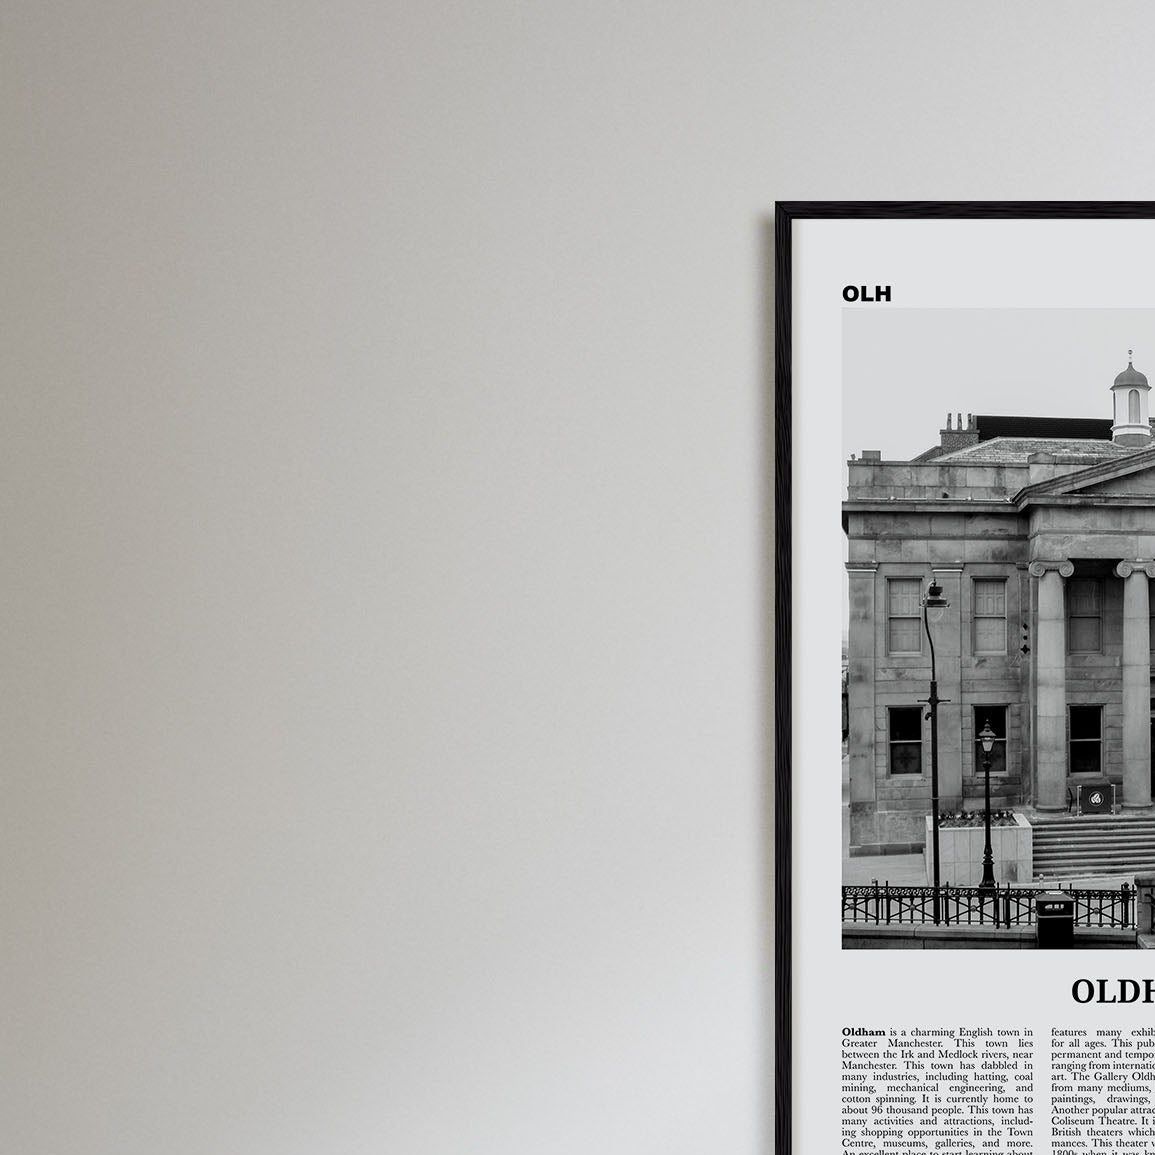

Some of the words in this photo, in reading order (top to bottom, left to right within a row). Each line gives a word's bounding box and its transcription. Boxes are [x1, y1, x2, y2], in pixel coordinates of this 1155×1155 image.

[842, 285, 891, 302] OLH
[841, 1028, 886, 1036] Oldham
[889, 1028, 898, 1036] is
[910, 1028, 956, 1039] charming
[959, 1028, 993, 1039] English
[1024, 1028, 1033, 1036] in
[1051, 1028, 1088, 1036] features
[1096, 1030, 1123, 1039] many
[841, 1039, 878, 1047] Greater
[887, 1039, 944, 1047] Manchester.
[953, 1039, 976, 1047] This
[1018, 1039, 1034, 1047] lies
[1051, 1039, 1065, 1047] for
[1068, 1039, 1080, 1047] all
[1084, 1042, 1107, 1050] ages.
[1111, 1039, 1133, 1047] This
[1051, 1051, 1102, 1061] permanent
[1104, 1050, 1122, 1058] and
[841, 1061, 898, 1070] Manchester.
[903, 1061, 925, 1070] This
[930, 1062, 954, 1070] town
[959, 1061, 976, 1070] has
[980, 1061, 1018, 1070] dabbled
[1024, 1062, 1033, 1070] in
[1051, 1062, 1087, 1072] ranging
[1088, 1061, 1111, 1070] from
[841, 1075, 868, 1083] many
[873, 1072, 920, 1082] industries,
[925, 1072, 969, 1083] including
[974, 1072, 1009, 1083] hatting,
[1014, 1072, 1033, 1081] coal
[841, 1084, 877, 1094] mining,
[886, 1083, 939, 1092] mechanical
[948, 1084, 1006, 1094] engineering,
[1015, 1083, 1034, 1092] and
[1051, 1083, 1074, 1092] from
[1077, 1086, 1104, 1094] many
[1107, 1083, 1152, 1093] mediums,
[1051, 1095, 1096, 1105] paintings,
[1106, 1094, 1151, 1105] drawings,
[841, 1128, 857, 1138] ing
[860, 1128, 904, 1138] shopping
[907, 1128, 969, 1138] opportunities
[973, 1128, 983, 1136] in
[987, 1128, 1003, 1136] the
[1006, 1128, 1033, 1136] Town
[1051, 1128, 1082, 1136] British
[1086, 1128, 1124, 1136] theaters
[1127, 1128, 1155, 1136] which
[841, 1139, 876, 1148] Centre,
[934, 1139, 976, 1150] galleries,
[982, 1139, 1000, 1147] and
